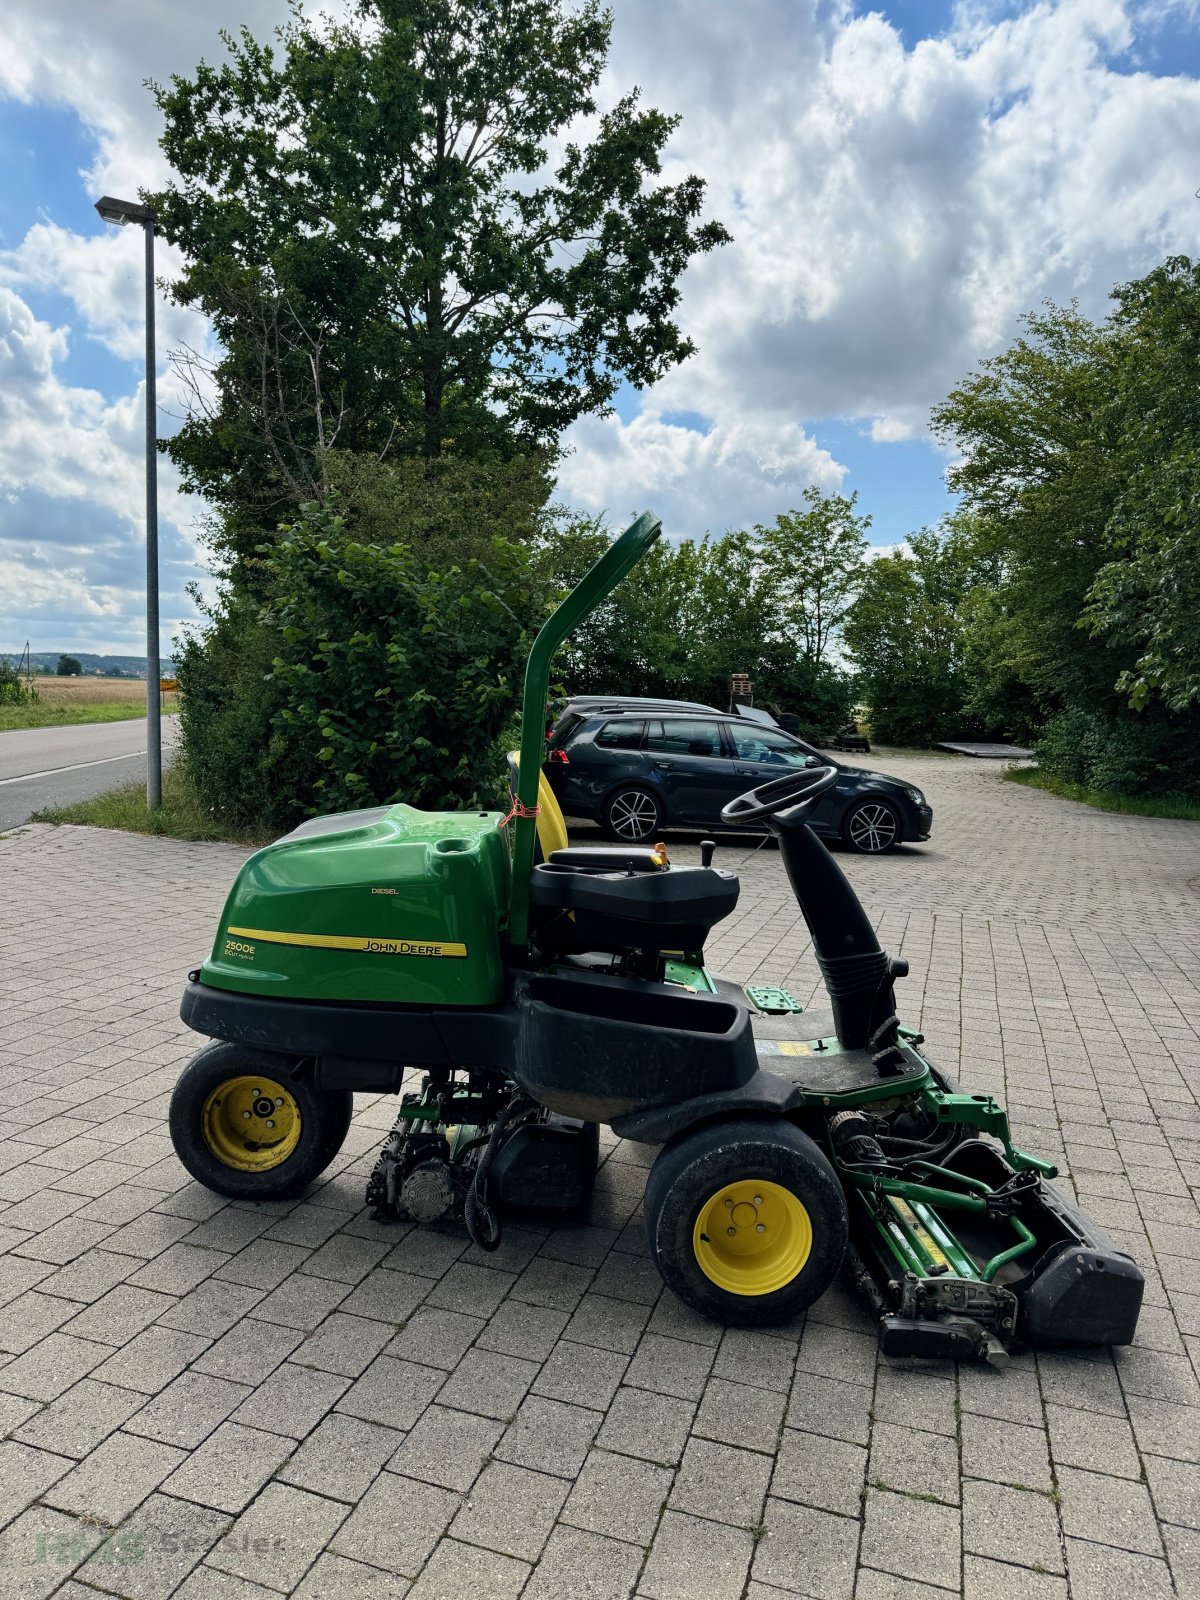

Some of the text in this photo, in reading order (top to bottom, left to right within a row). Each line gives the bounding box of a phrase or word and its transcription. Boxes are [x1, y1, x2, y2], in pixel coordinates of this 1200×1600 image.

[225, 940, 256, 955] 2500E
[363, 940, 443, 956] JOHN DEERE
